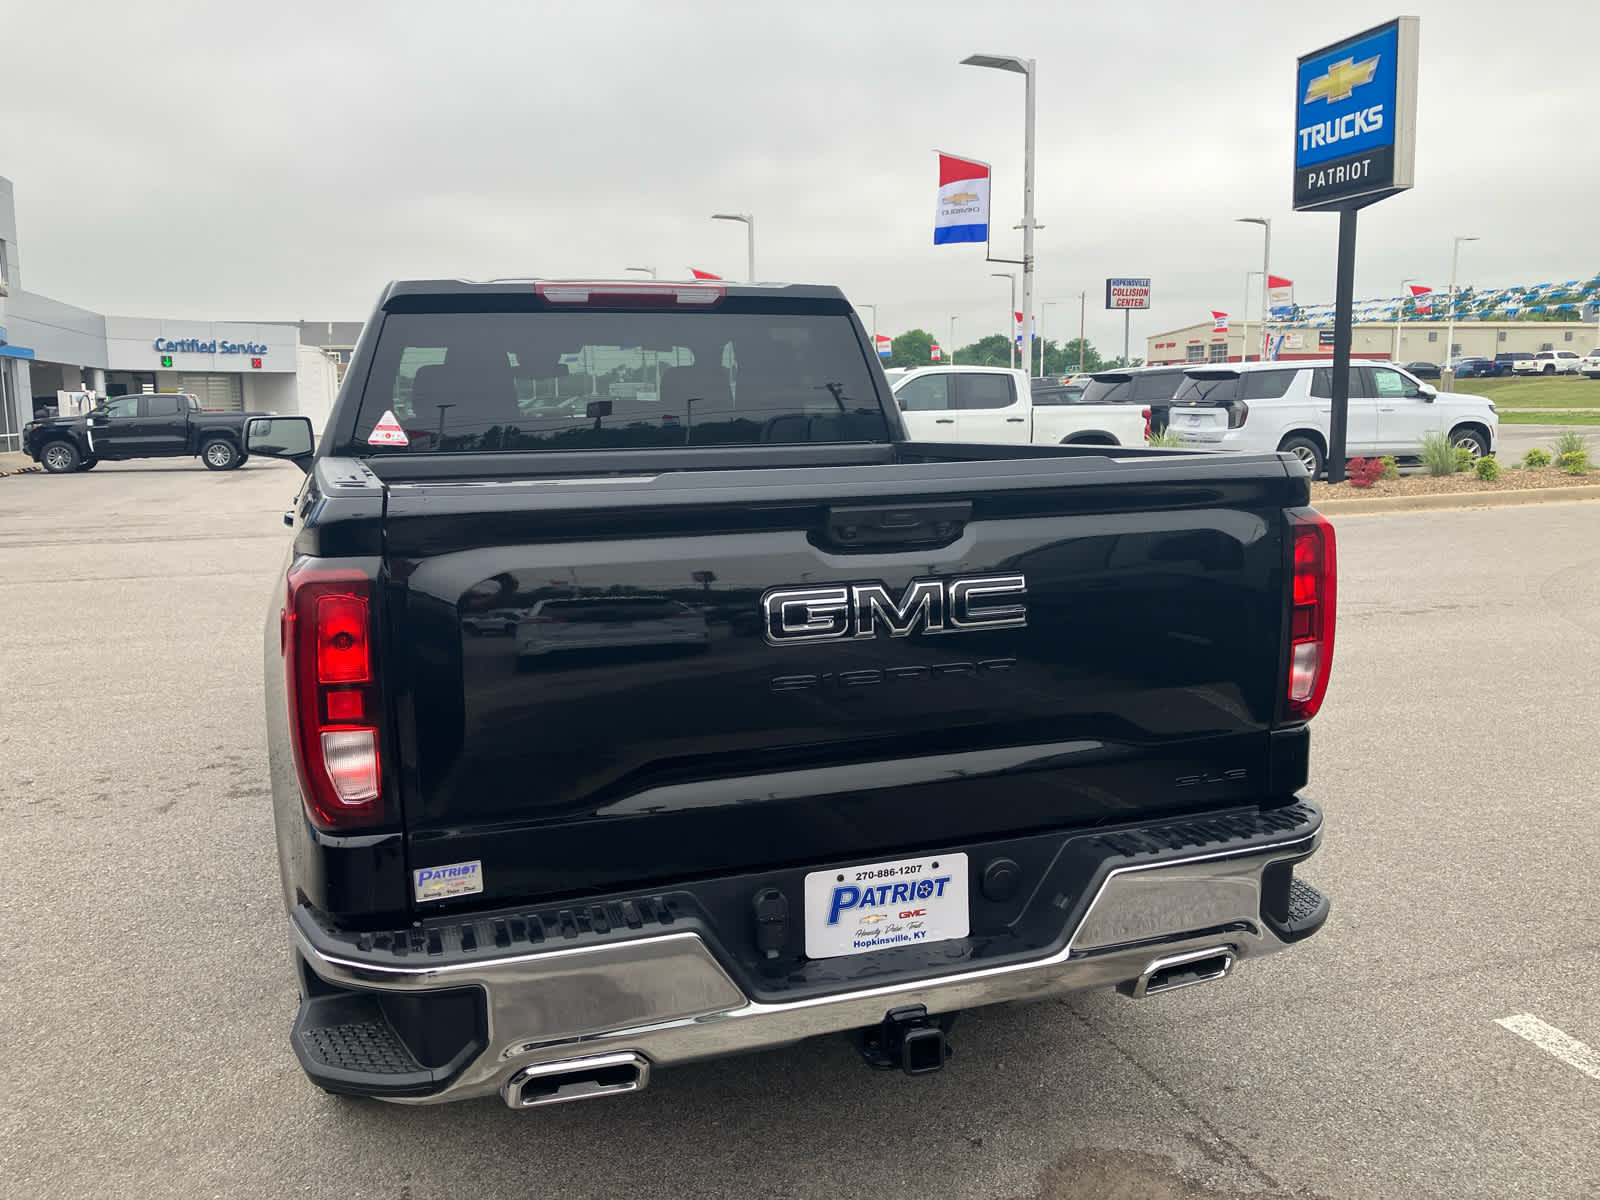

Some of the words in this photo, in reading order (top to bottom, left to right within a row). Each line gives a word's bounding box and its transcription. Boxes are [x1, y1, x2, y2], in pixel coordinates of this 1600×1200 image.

[1300, 104, 1383, 151] TRUCKS
[1308, 160, 1370, 190] PATRIOT
[1112, 288, 1148, 296] COLLISION
[1116, 298, 1144, 306] CENTER
[155, 337, 216, 353] Certified
[219, 340, 267, 354] Service
[762, 573, 1027, 647] GMC
[418, 864, 477, 887] PATRIOT
[856, 865, 922, 880] 270-886-1207
[826, 877, 950, 925] PATRIOT
[899, 908, 927, 918] GMC
[853, 934, 911, 948] Hopkinsville,
[914, 930, 926, 939] KY
